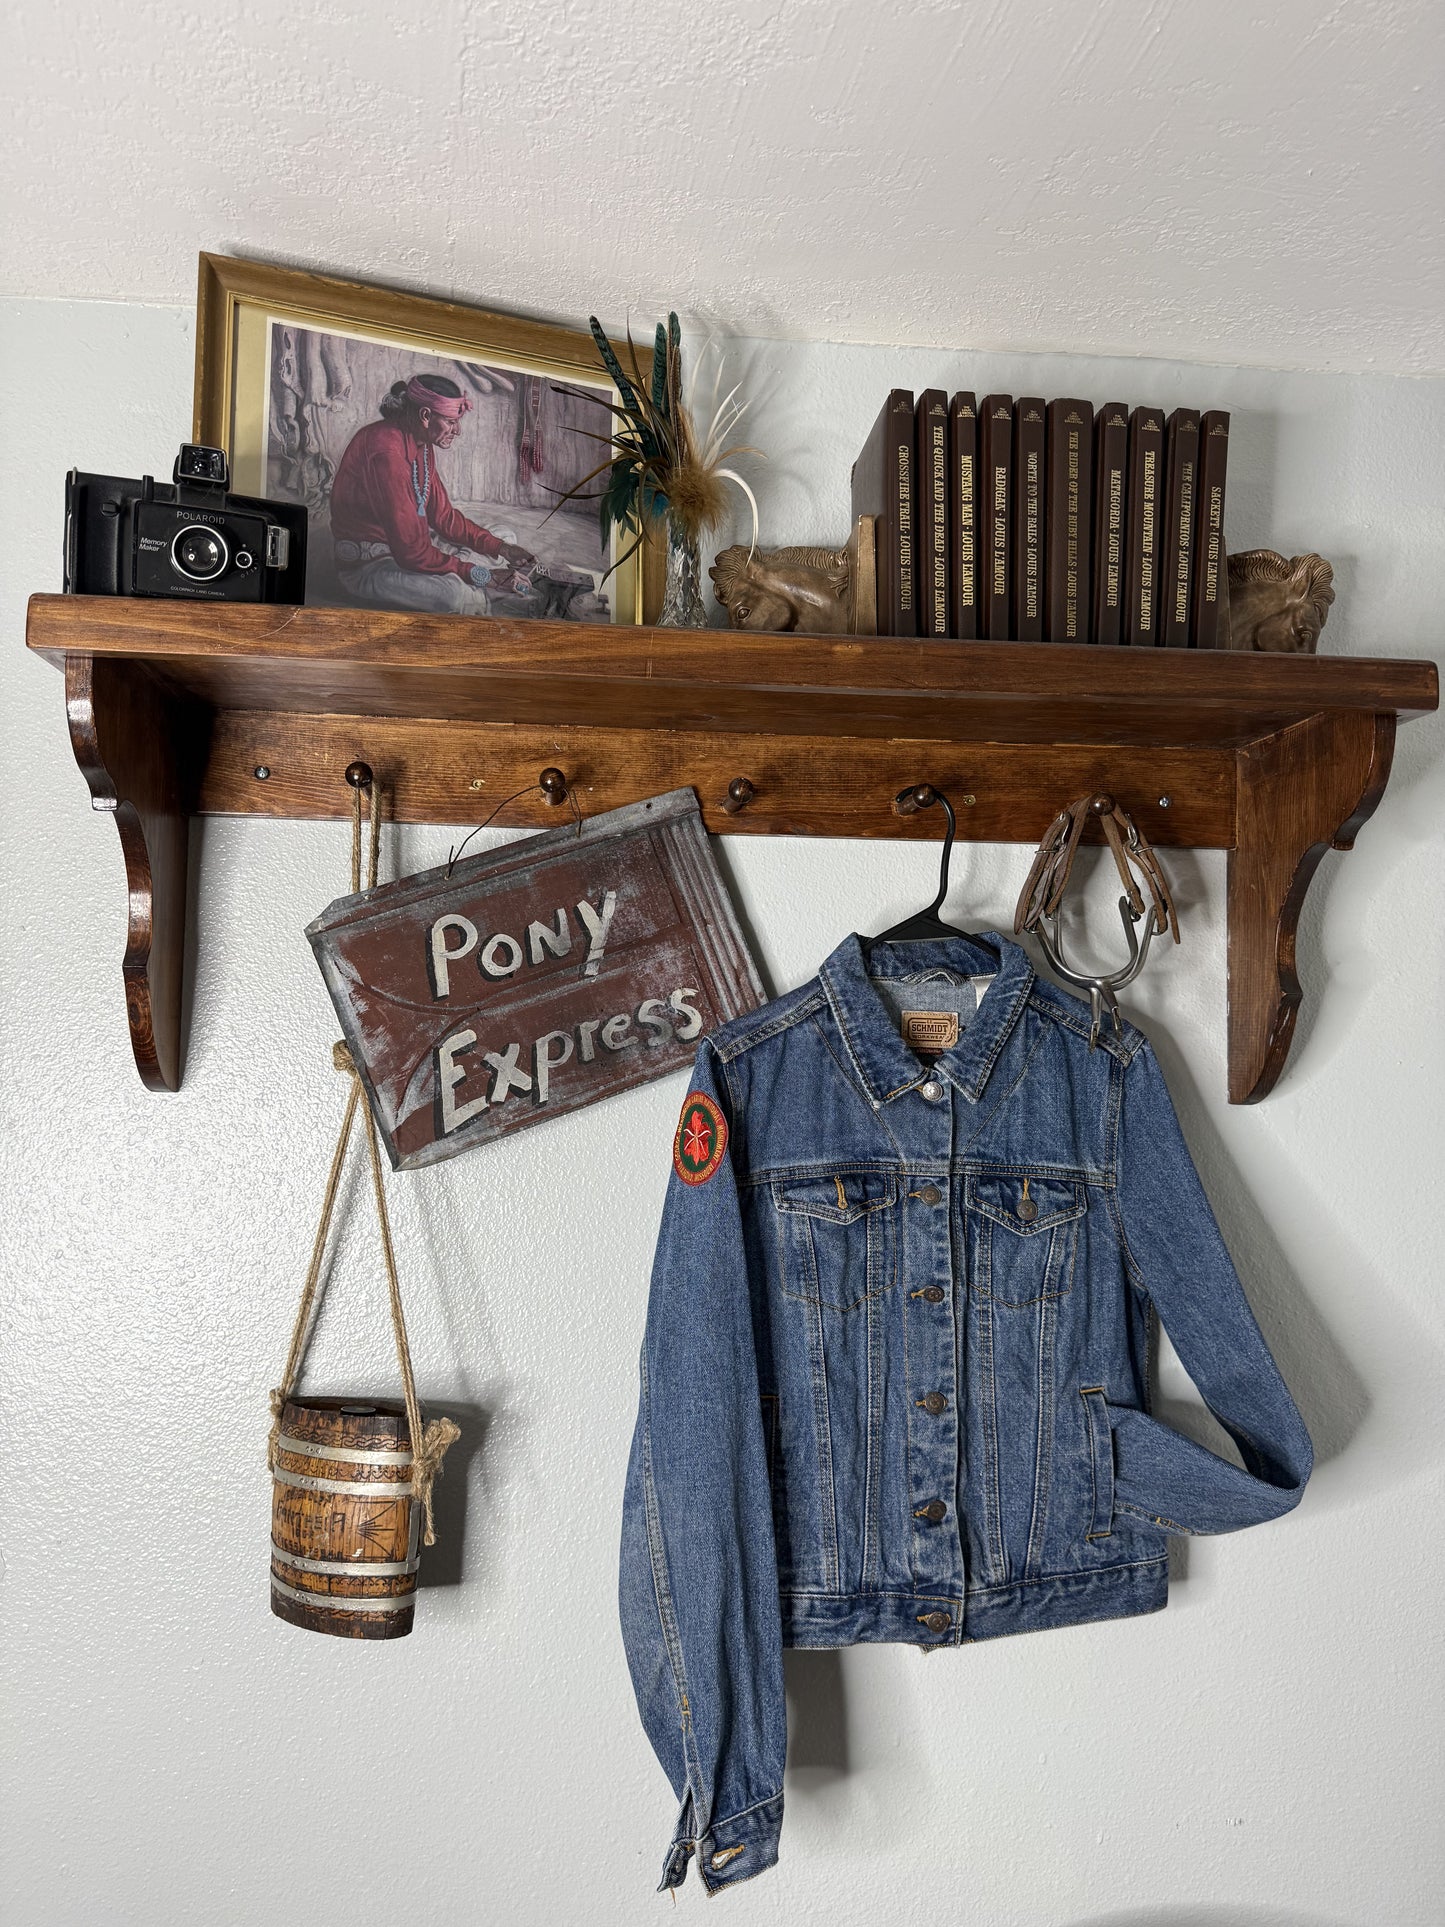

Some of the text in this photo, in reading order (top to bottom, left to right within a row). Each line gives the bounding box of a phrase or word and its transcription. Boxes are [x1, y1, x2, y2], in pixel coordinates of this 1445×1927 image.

[934, 425, 943, 446] THE
[1070, 430, 1078, 449] THE
[934, 447, 943, 478] QUICK
[1069, 450, 1078, 479] RIDER
[935, 479, 944, 501] AND
[1069, 480, 1078, 494] OF
[176, 511, 225, 524] POLAROID
[935, 503, 944, 523] THE
[1069, 494, 1077, 513] THE
[899, 445, 910, 610] CROSSFIRE TRAIL LOUIS L'AMOUR
[935, 524, 944, 552] DEAD
[962, 454, 973, 606] MUSTANG MAN LOUIS L'AMOUR
[995, 466, 1005, 594] RADIGAN LOUIS L'AMOUR
[1027, 451, 1037, 617] NORTH TO THE RAILS LOUIS L'AMOUR
[1069, 514, 1077, 538] RUBY
[1108, 469, 1120, 606] MATAGORDA LOUIS L'AMOUR
[1141, 450, 1154, 630] TREASURE MOUNTAIN LOUIS L'AMOUR
[139, 544, 160, 552] Maker
[140, 537, 167, 546] Memory
[1068, 539, 1077, 567] HILLS
[1176, 462, 1192, 623] THE CALIFORNIOS LOUIS L'AMOUR
[1207, 486, 1221, 601] SACKETT LOUIS L'AMOUR
[935, 556, 944, 587] LOUIS
[1068, 570, 1076, 597] LOUIS
[935, 589, 945, 632] L'AMOUR
[1067, 599, 1076, 637] L'AMOUR
[912, 1024, 948, 1032] SCHMIDT
